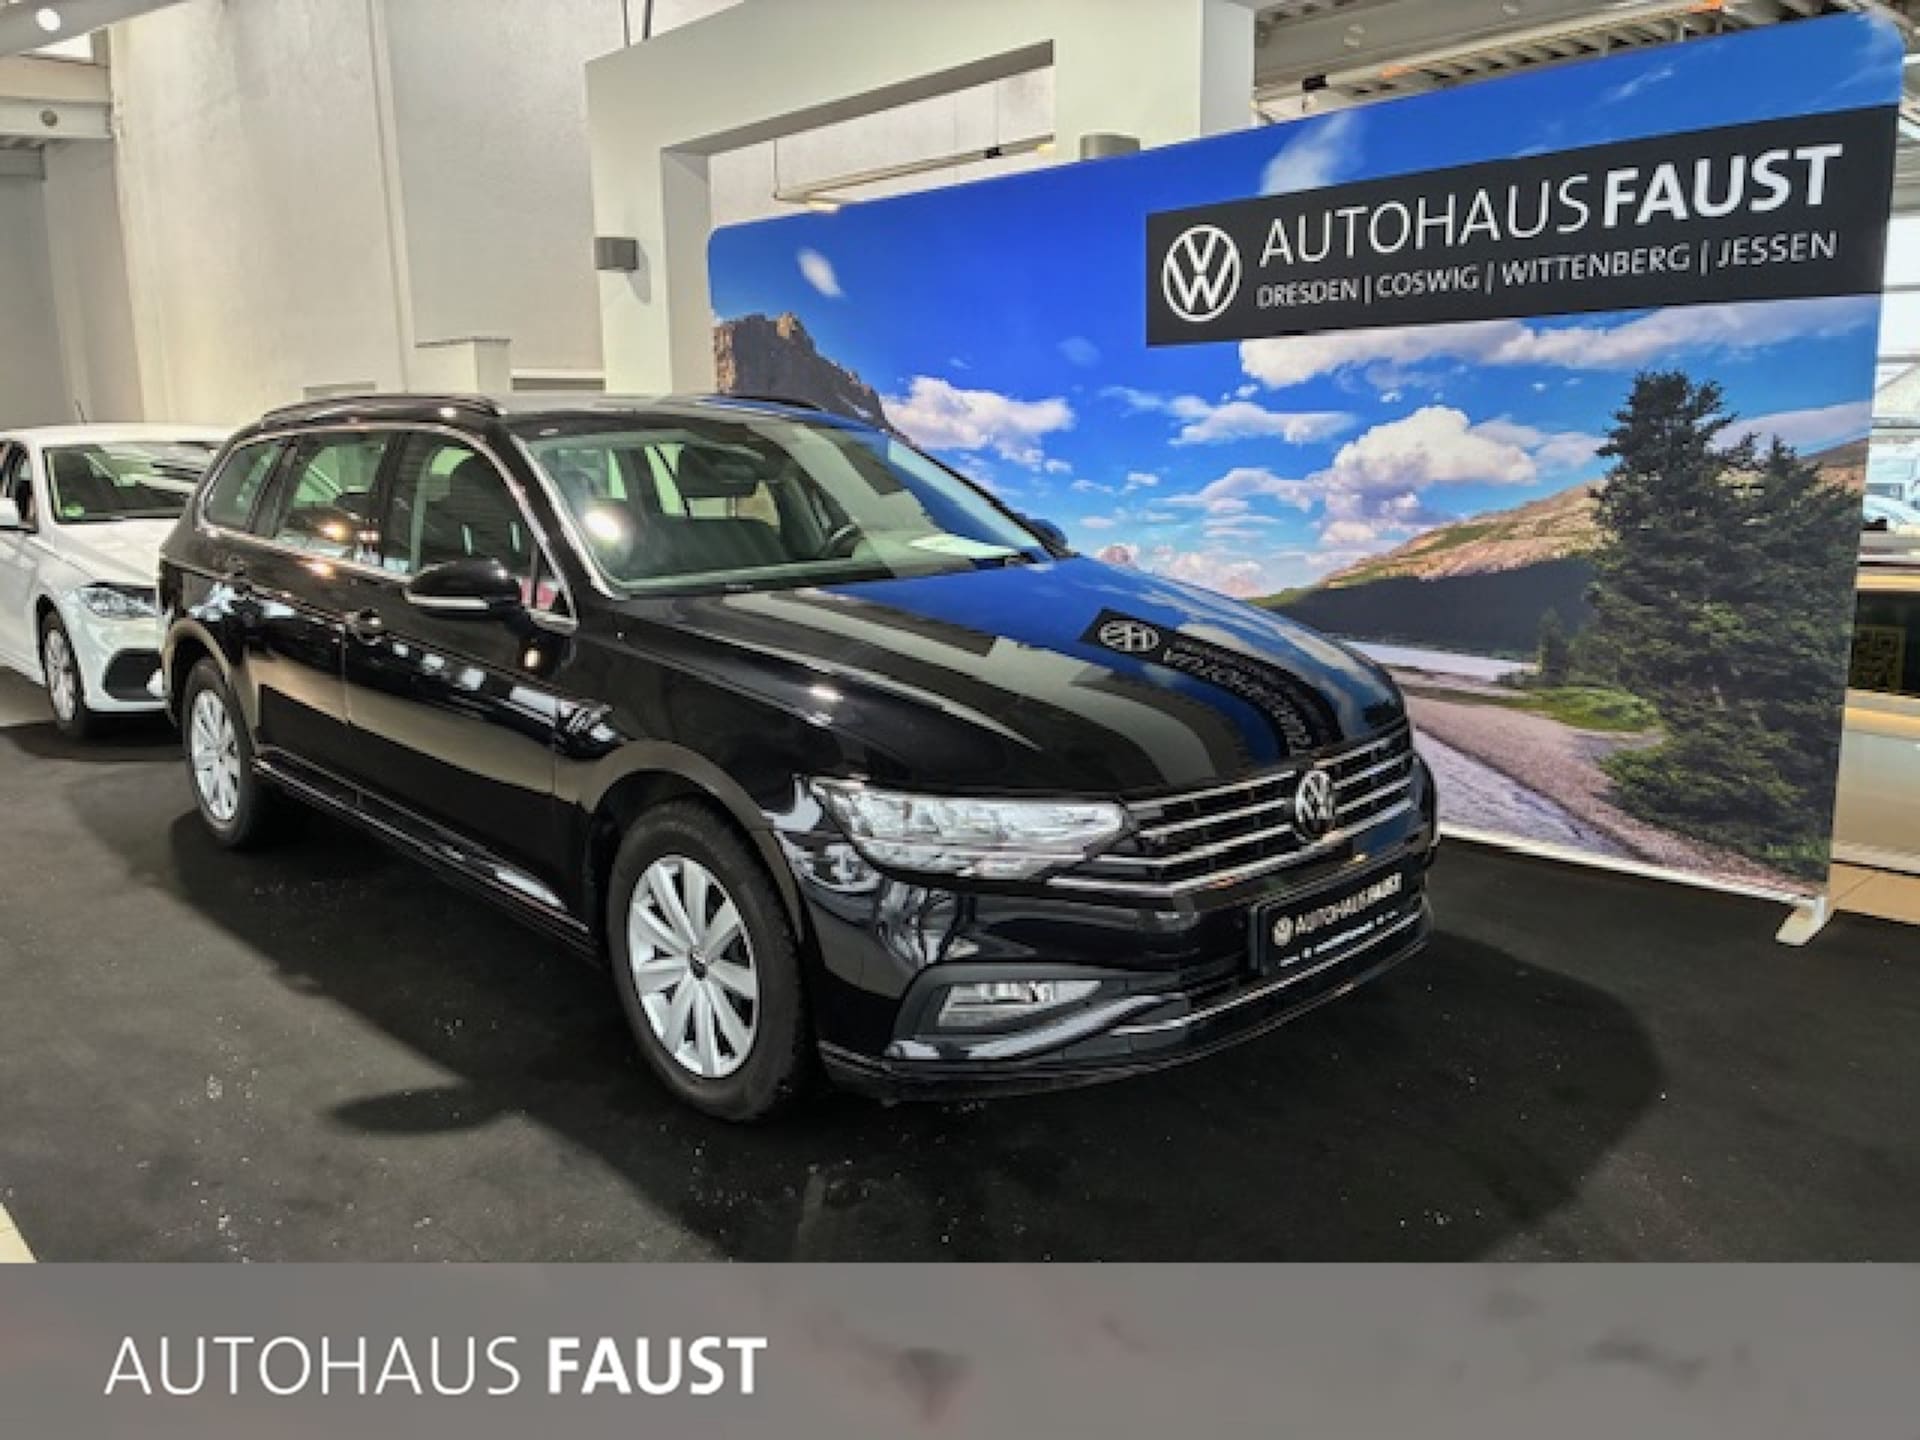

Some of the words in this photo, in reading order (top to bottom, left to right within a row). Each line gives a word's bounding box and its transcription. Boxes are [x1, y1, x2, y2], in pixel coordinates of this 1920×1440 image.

[1258, 173, 1590, 268] AUTOHAUS
[1603, 143, 1843, 228] FAUST
[1256, 278, 1358, 309] DRESDEN
[1375, 265, 1479, 298] COSWIG
[1502, 241, 1691, 286] WITTENBERG
[1716, 230, 1838, 268] JESSEN
